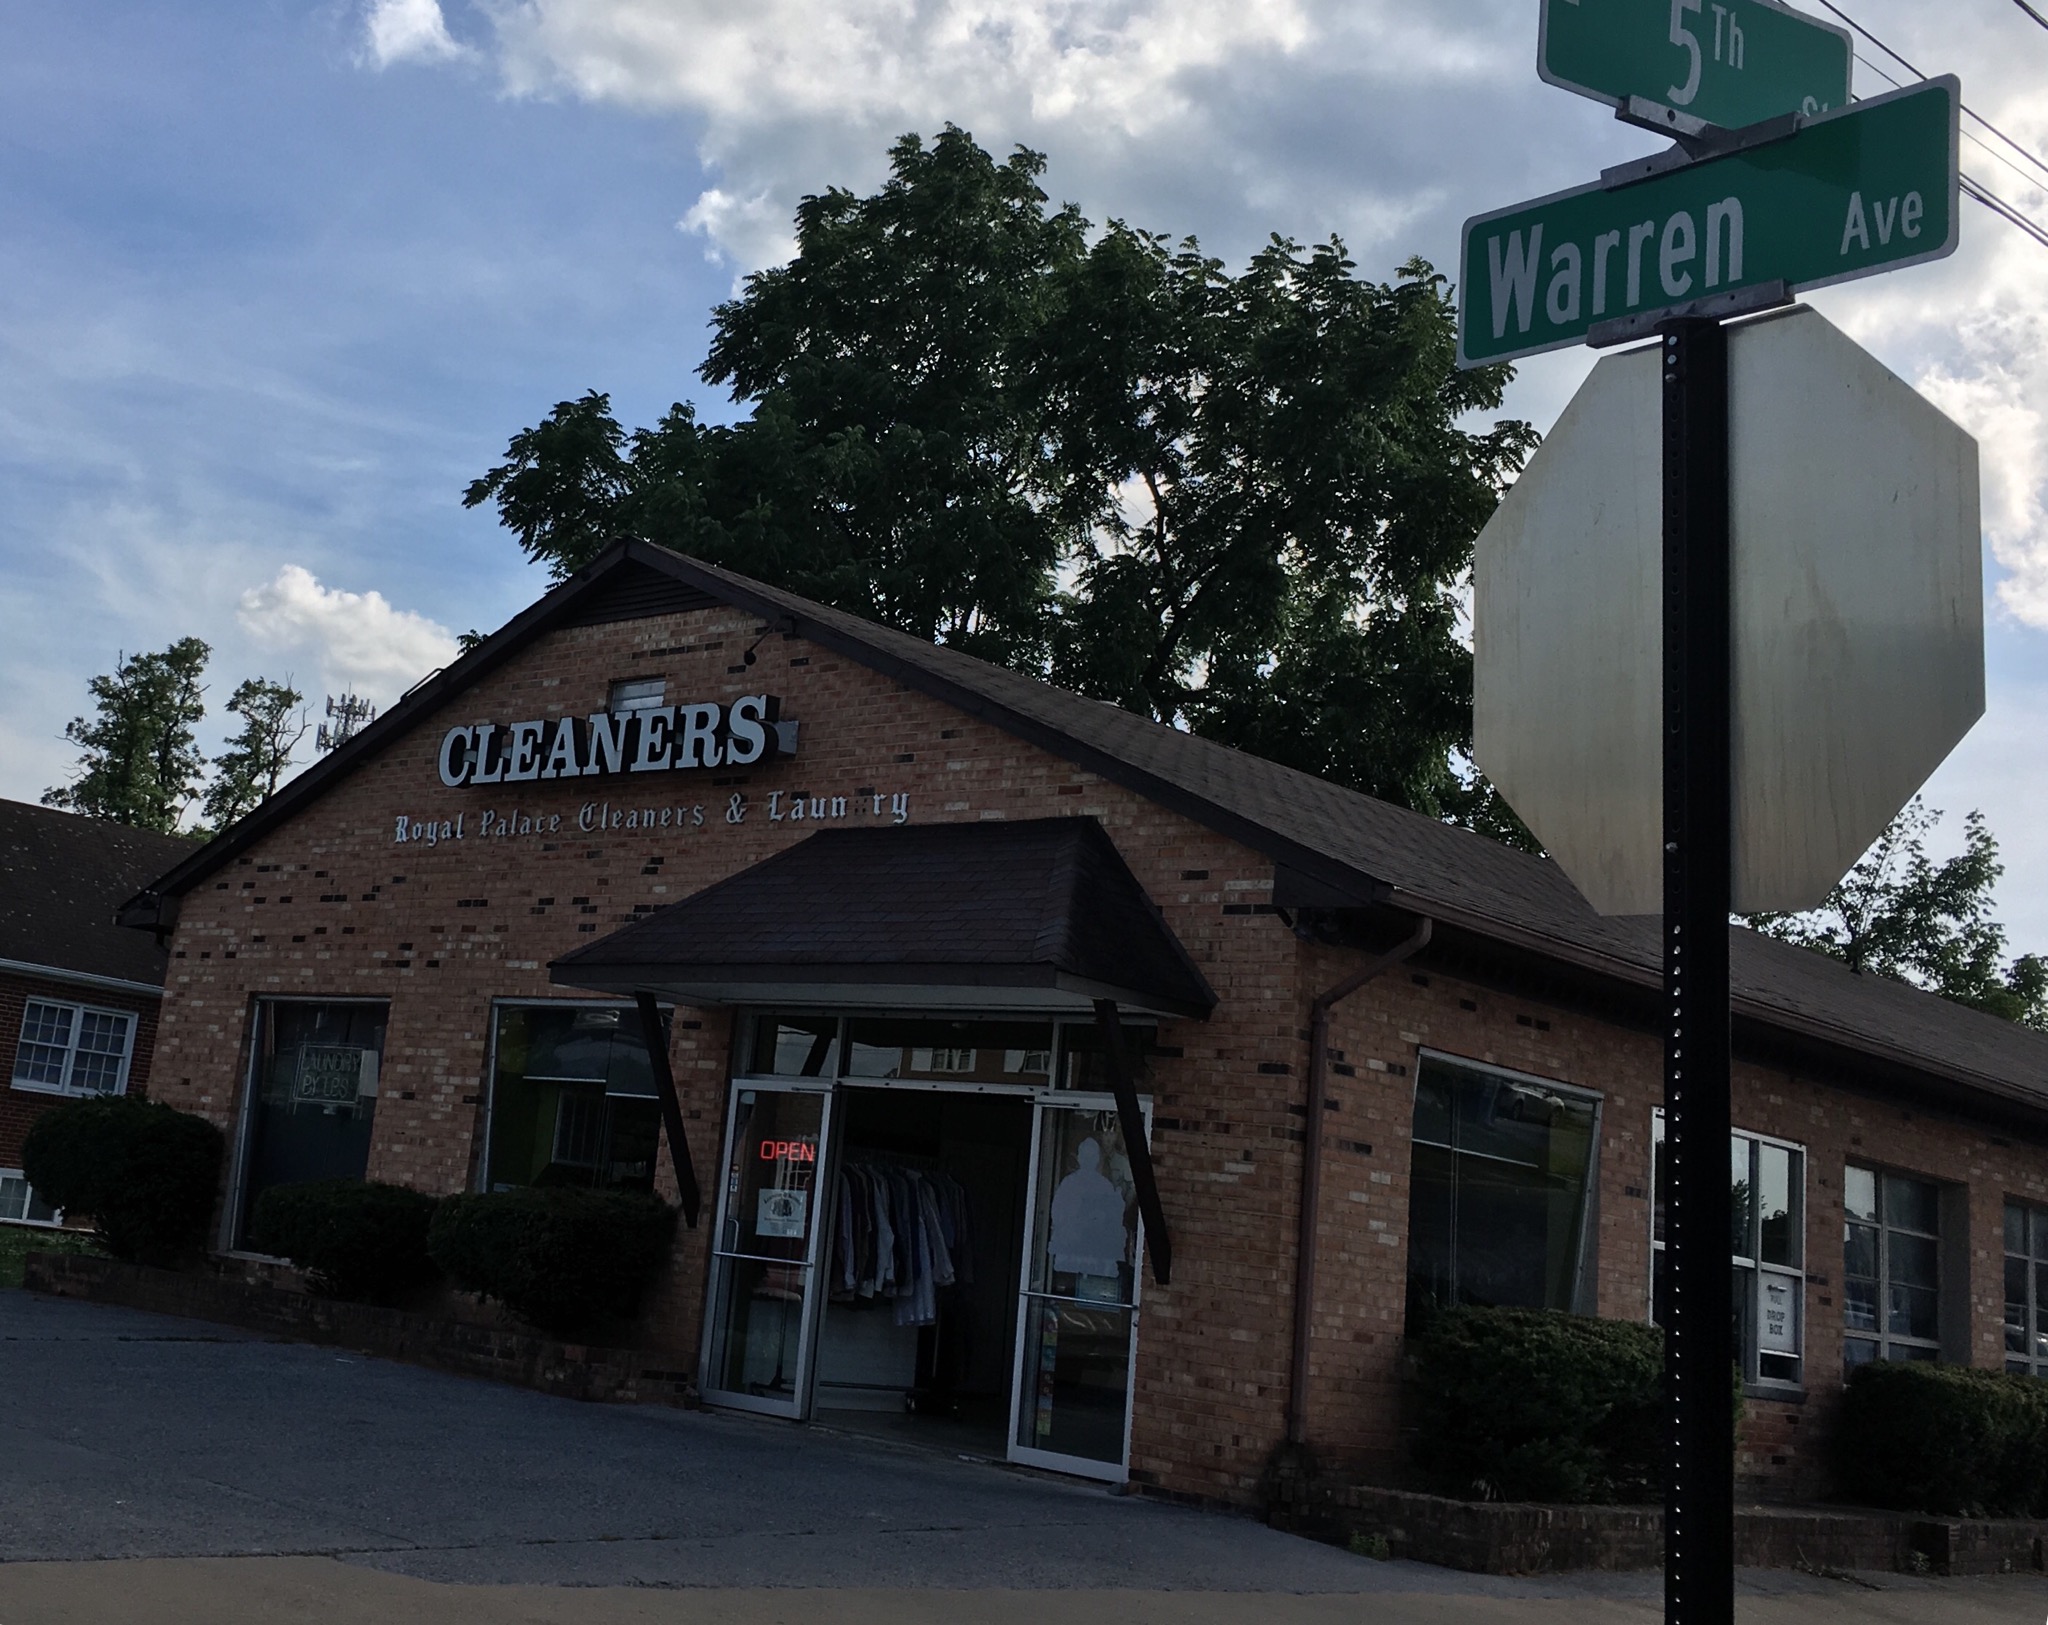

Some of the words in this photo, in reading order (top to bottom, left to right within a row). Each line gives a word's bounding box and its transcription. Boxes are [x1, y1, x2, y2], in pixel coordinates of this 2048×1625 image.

[1487, 197, 1744, 339] Warren
[1839, 190, 1924, 256] Ave
[438, 694, 769, 788] CLEANERS
[394, 811, 465, 848] Royal
[479, 808, 562, 837] Palace
[578, 801, 706, 833] Cleaners
[725, 792, 748, 824] &
[766, 790, 910, 824] Launry
[302, 1075, 320, 1096] BY
[760, 1139, 814, 1162] OPEN
[1767, 1309, 1785, 1322] DROP
[1769, 1323, 1784, 1336] BOX
